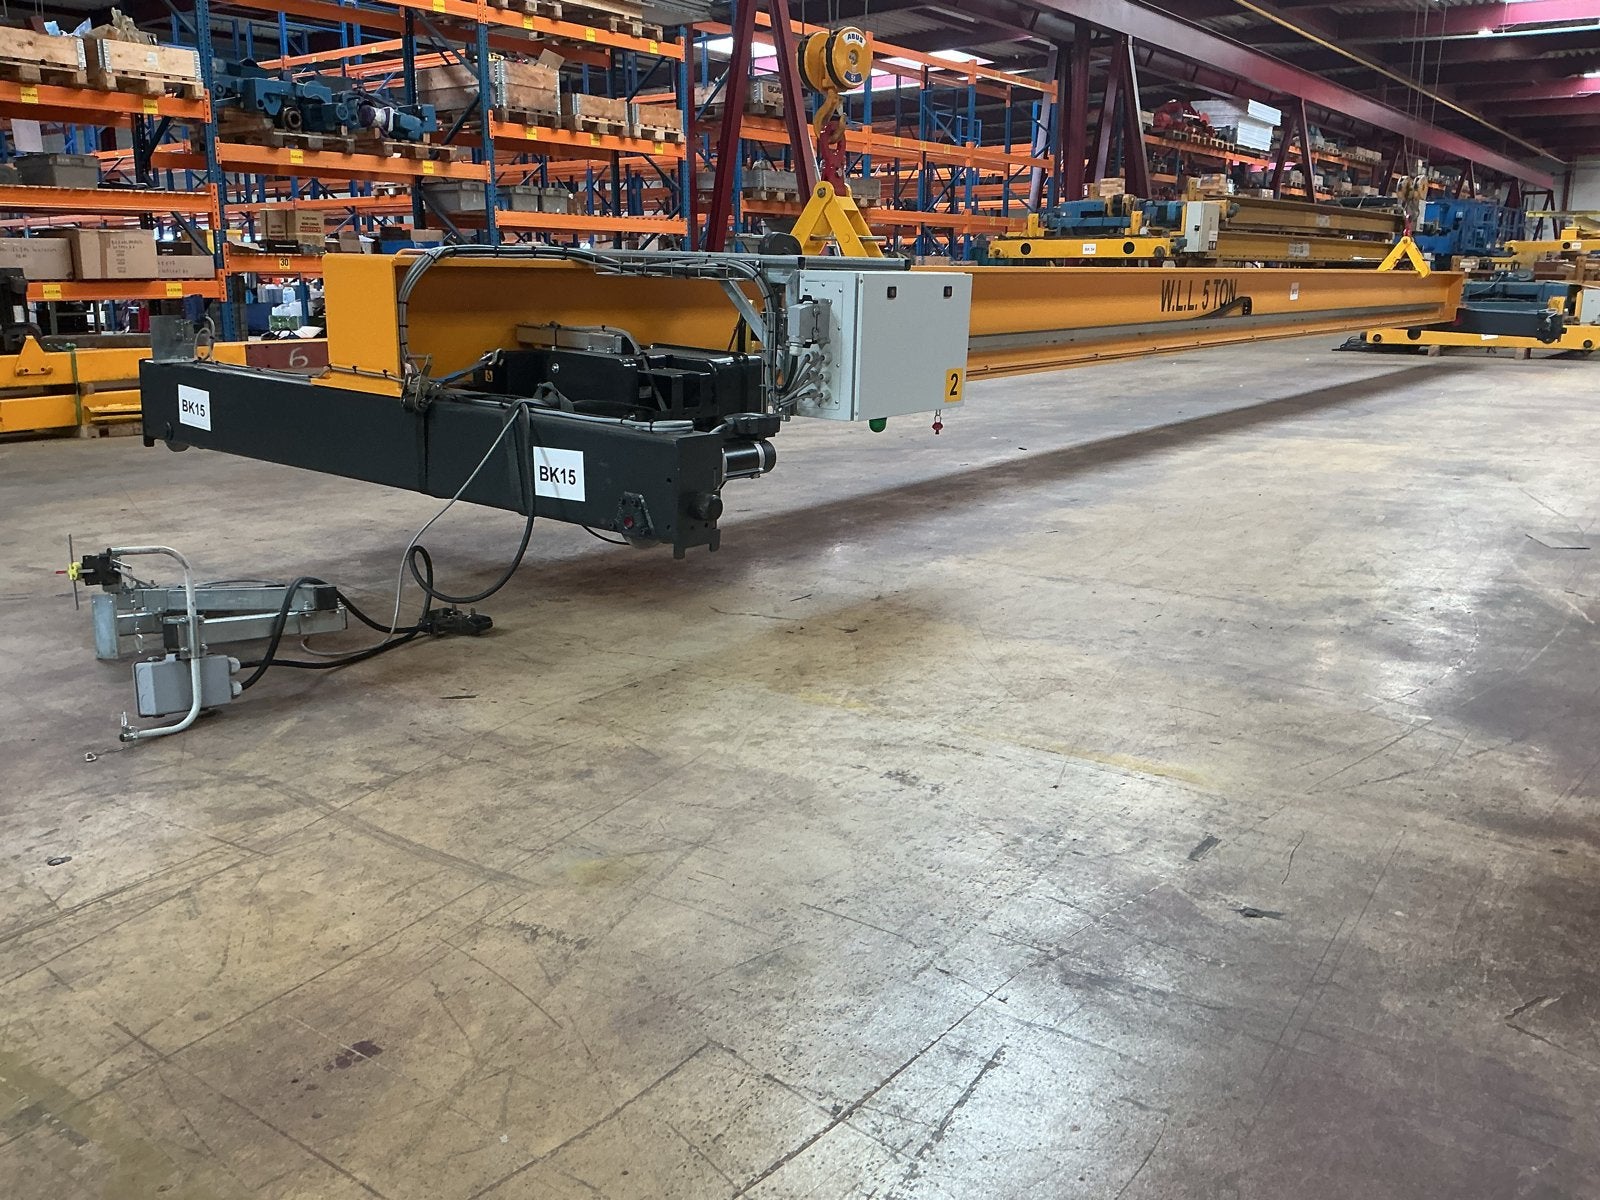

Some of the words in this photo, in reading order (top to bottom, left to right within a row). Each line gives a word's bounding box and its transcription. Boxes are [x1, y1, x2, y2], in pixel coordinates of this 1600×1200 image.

[847, 33, 863, 43] ABUS
[280, 258, 289, 267] 30
[1161, 279, 1198, 312] W.L.L.
[1202, 279, 1211, 310] 5
[1213, 278, 1238, 309] TON
[288, 347, 309, 368] 6
[949, 373, 959, 396] 2
[181, 398, 206, 418] BK15
[539, 465, 577, 486] BK15
